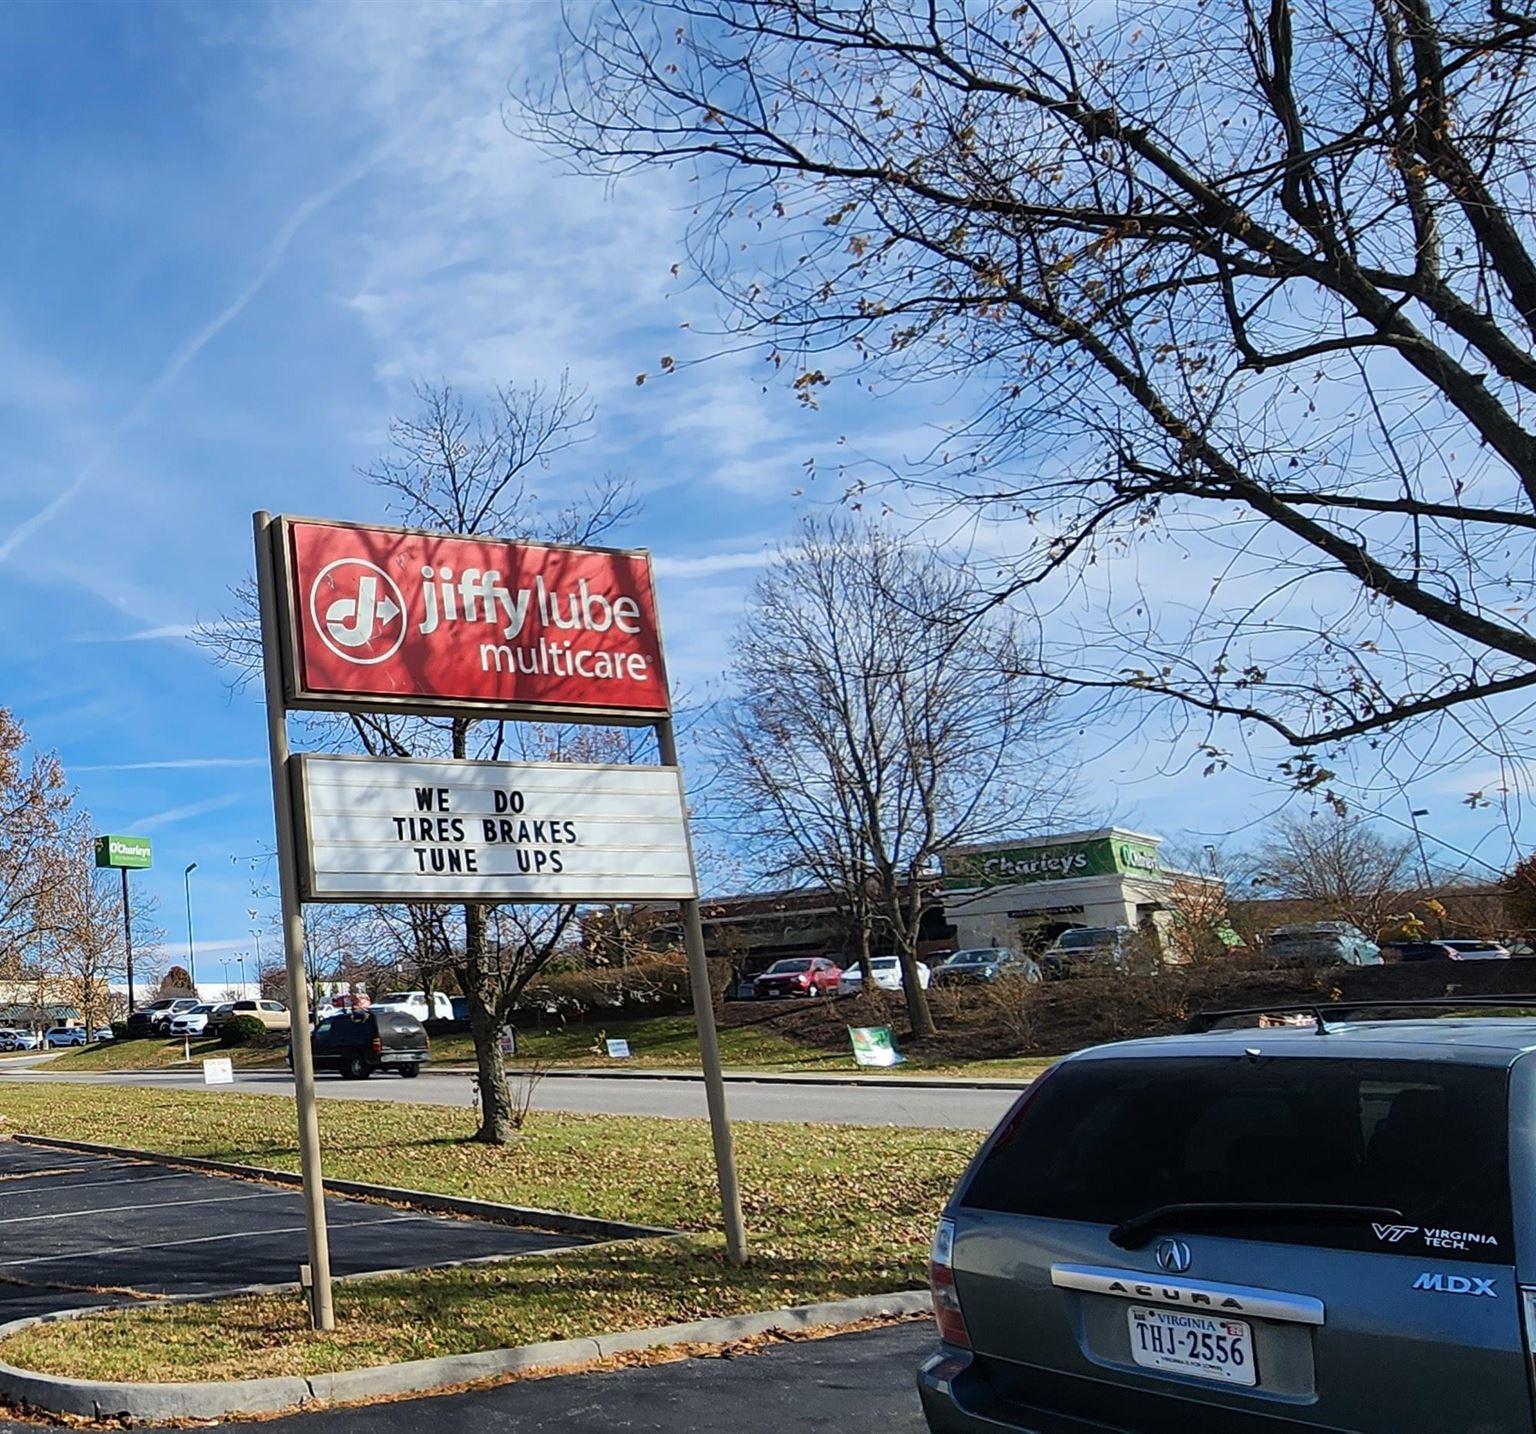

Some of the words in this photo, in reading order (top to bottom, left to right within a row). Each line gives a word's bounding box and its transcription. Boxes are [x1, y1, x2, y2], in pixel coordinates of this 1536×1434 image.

[419, 565, 531, 640] jiffy
[536, 575, 641, 634] lube
[480, 637, 648, 681] multicare
[414, 787, 450, 812] WE
[493, 789, 525, 814] DO
[392, 817, 465, 842] TIRES
[482, 818, 577, 844] BRAKES
[414, 848, 478, 872] TUNE
[516, 850, 563, 873] UPS
[1423, 1227, 1499, 1246] VIRGINIA
[1424, 1236, 1465, 1250] TECH
[1108, 1281, 1244, 1310] ACURA
[1412, 1272, 1498, 1298] MDX
[1156, 1314, 1217, 1332] VIRGINIA
[1136, 1323, 1244, 1366] THJ-2556
